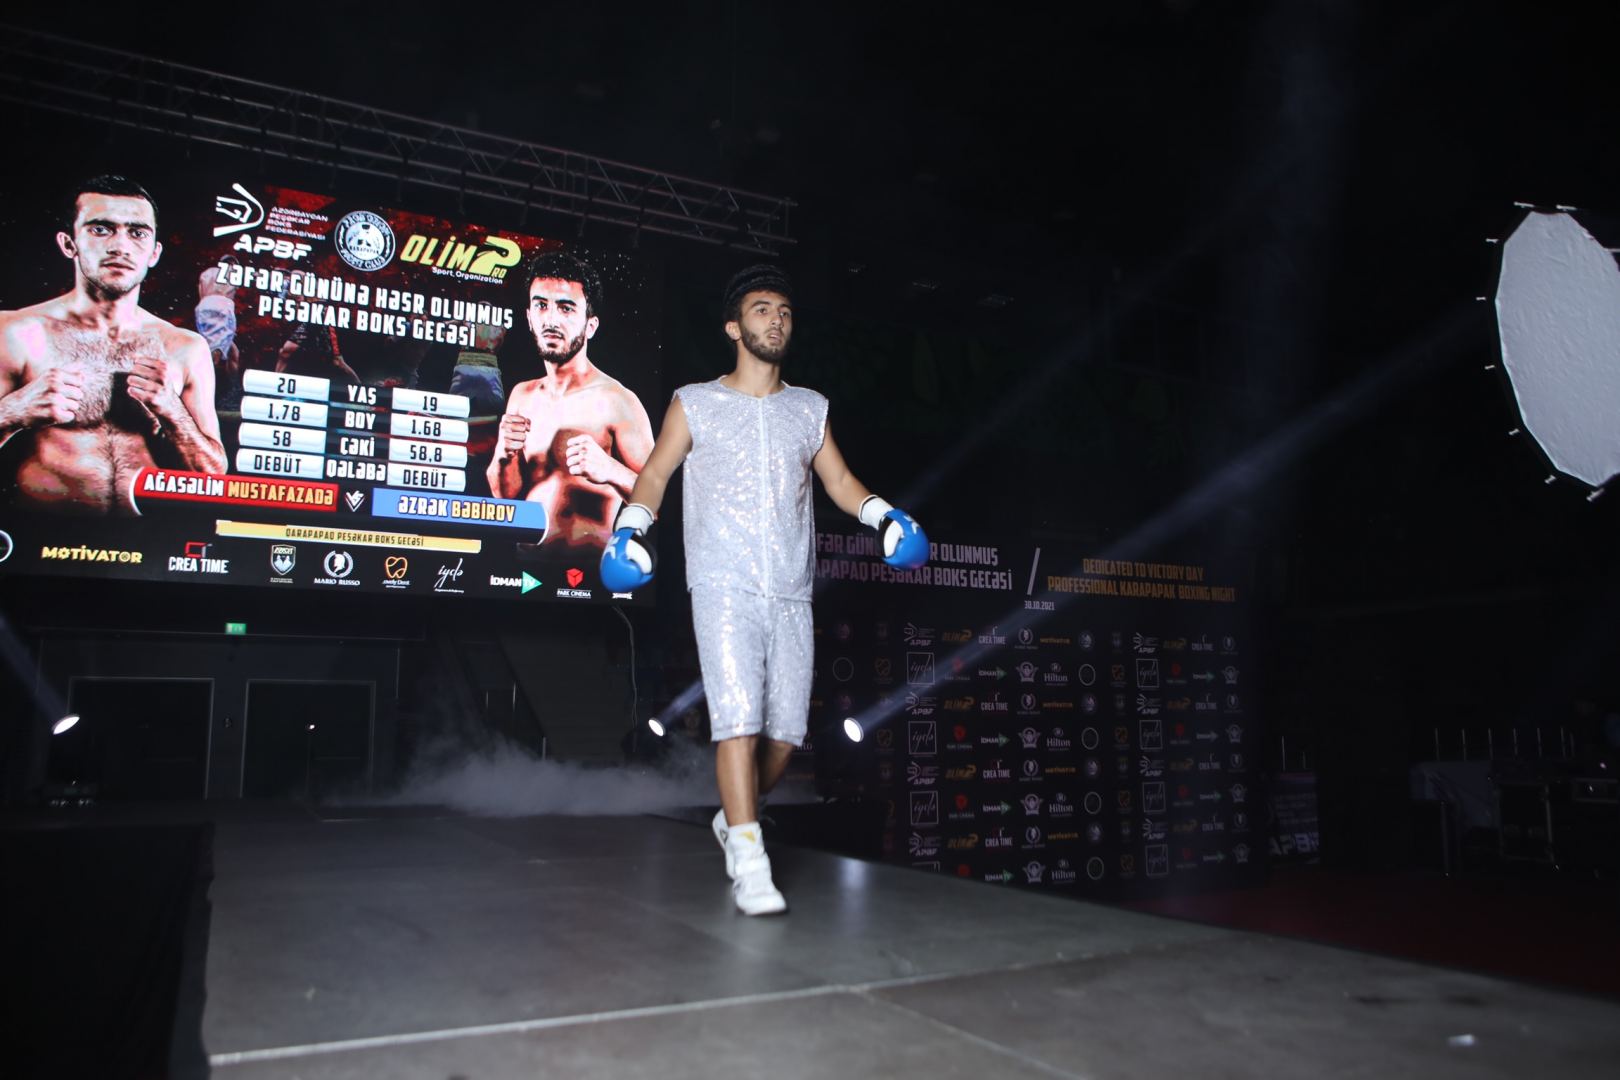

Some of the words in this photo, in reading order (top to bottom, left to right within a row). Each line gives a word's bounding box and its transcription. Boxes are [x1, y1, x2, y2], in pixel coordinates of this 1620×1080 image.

[233, 233, 312, 261] APBF
[455, 271, 503, 285] Organization
[257, 294, 350, 329] PEŞƏKAR
[356, 309, 406, 337] BOKS
[412, 319, 476, 348] GECƏSİ
[430, 296, 513, 330] OLUNMUŞ
[276, 377, 297, 394] 20
[267, 402, 301, 422] 1.78
[422, 395, 438, 412] 19
[344, 410, 376, 430] BOY
[411, 419, 442, 437] 1.68
[273, 430, 292, 447] 58
[254, 453, 302, 474] DEBÜT
[403, 468, 447, 488] DEBÜT
[375, 535, 395, 544] BOKS
[816, 532, 847, 553] FƏR
[168, 557, 198, 572] CREA
[200, 558, 229, 574] TIME
[1082, 558, 1134, 577] DEDICATED
[1134, 561, 1147, 578] TO
[1147, 562, 1185, 580] VICTORY
[1185, 565, 1204, 582] DAY
[934, 567, 968, 587] BOKS
[1047, 575, 1119, 596] PROFESSIONAL
[1119, 581, 1176, 600] KARAPAPAK
[1179, 584, 1211, 601] BOXING
